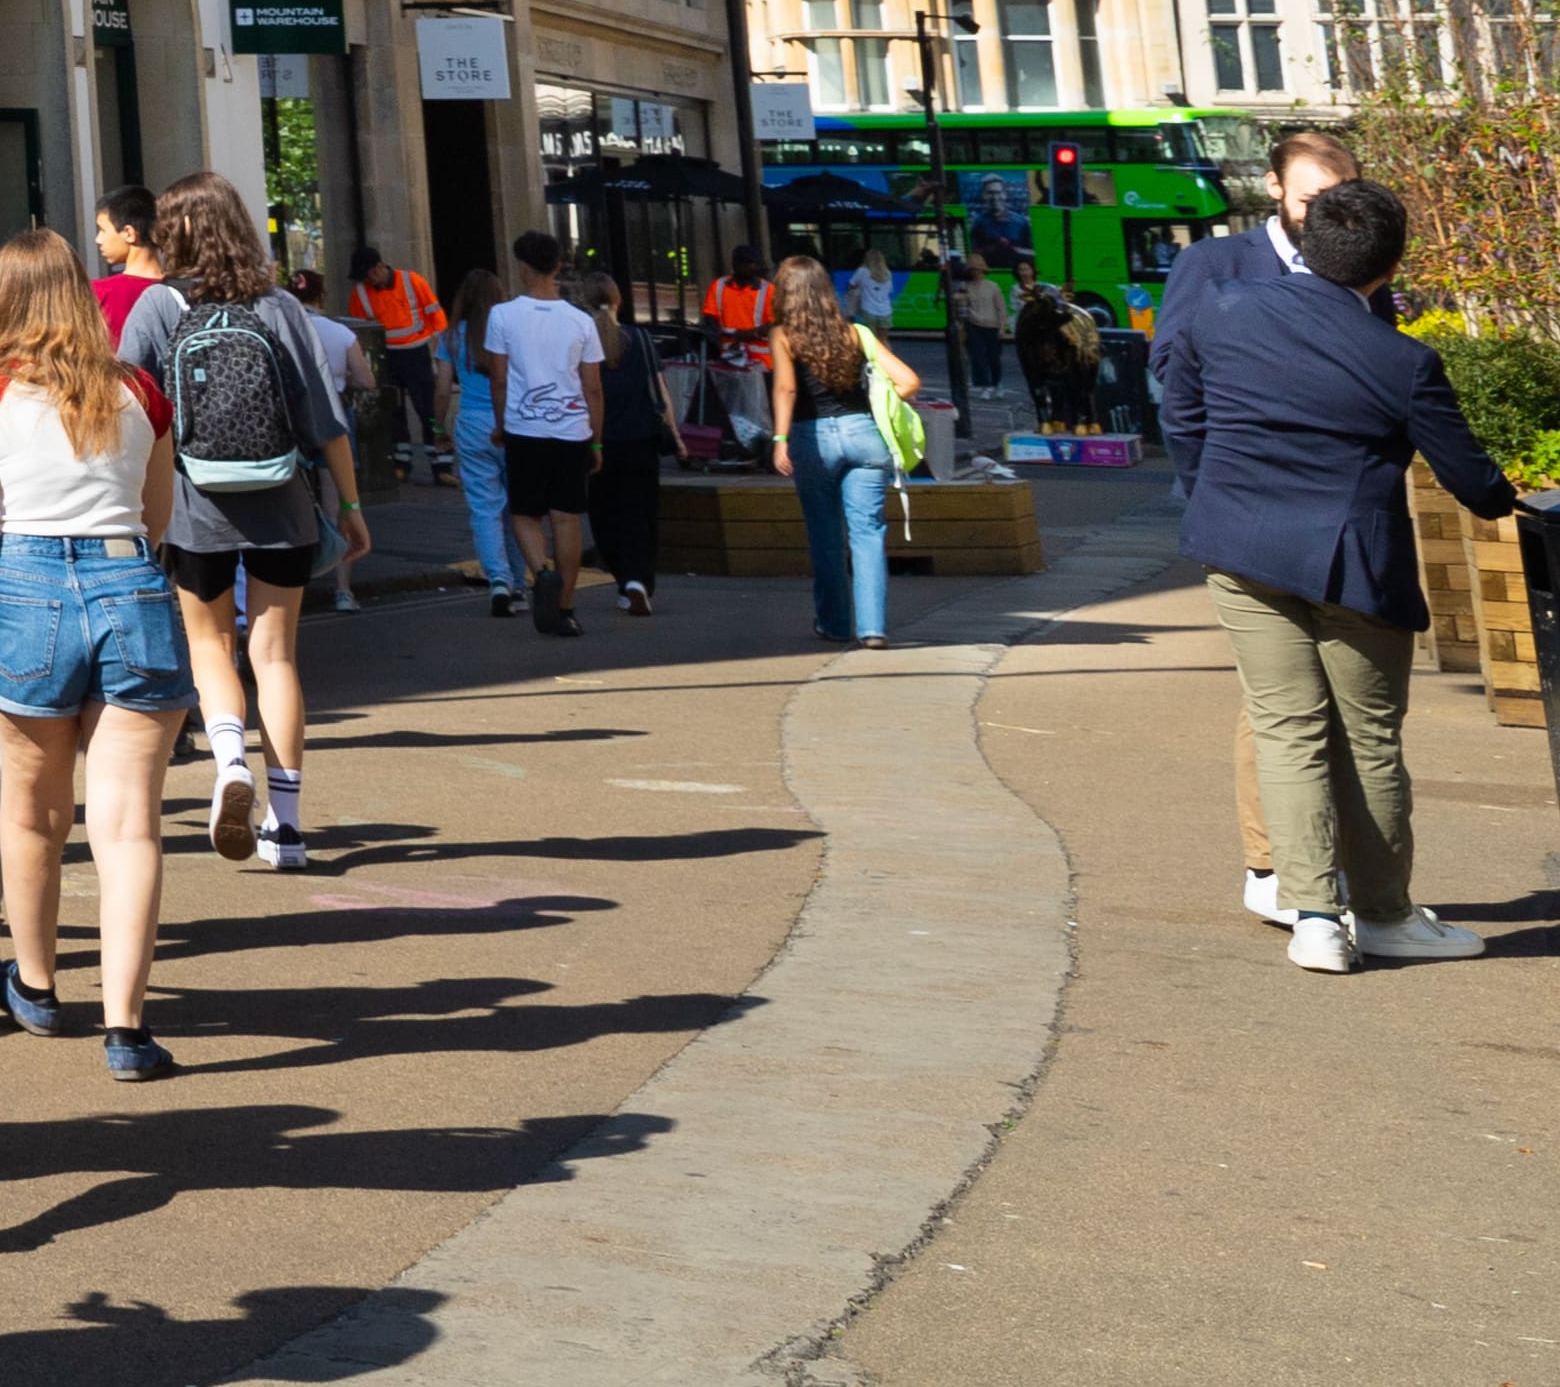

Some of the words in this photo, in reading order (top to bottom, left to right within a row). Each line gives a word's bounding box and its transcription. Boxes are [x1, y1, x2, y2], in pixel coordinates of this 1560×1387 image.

[256, 8, 325, 17] MOUNTAIN
[256, 16, 339, 26] WAREHOUSE
[446, 58, 479, 69] THE
[435, 70, 493, 82] STORE
[768, 109, 793, 117] THE
[761, 119, 803, 127] STORE
